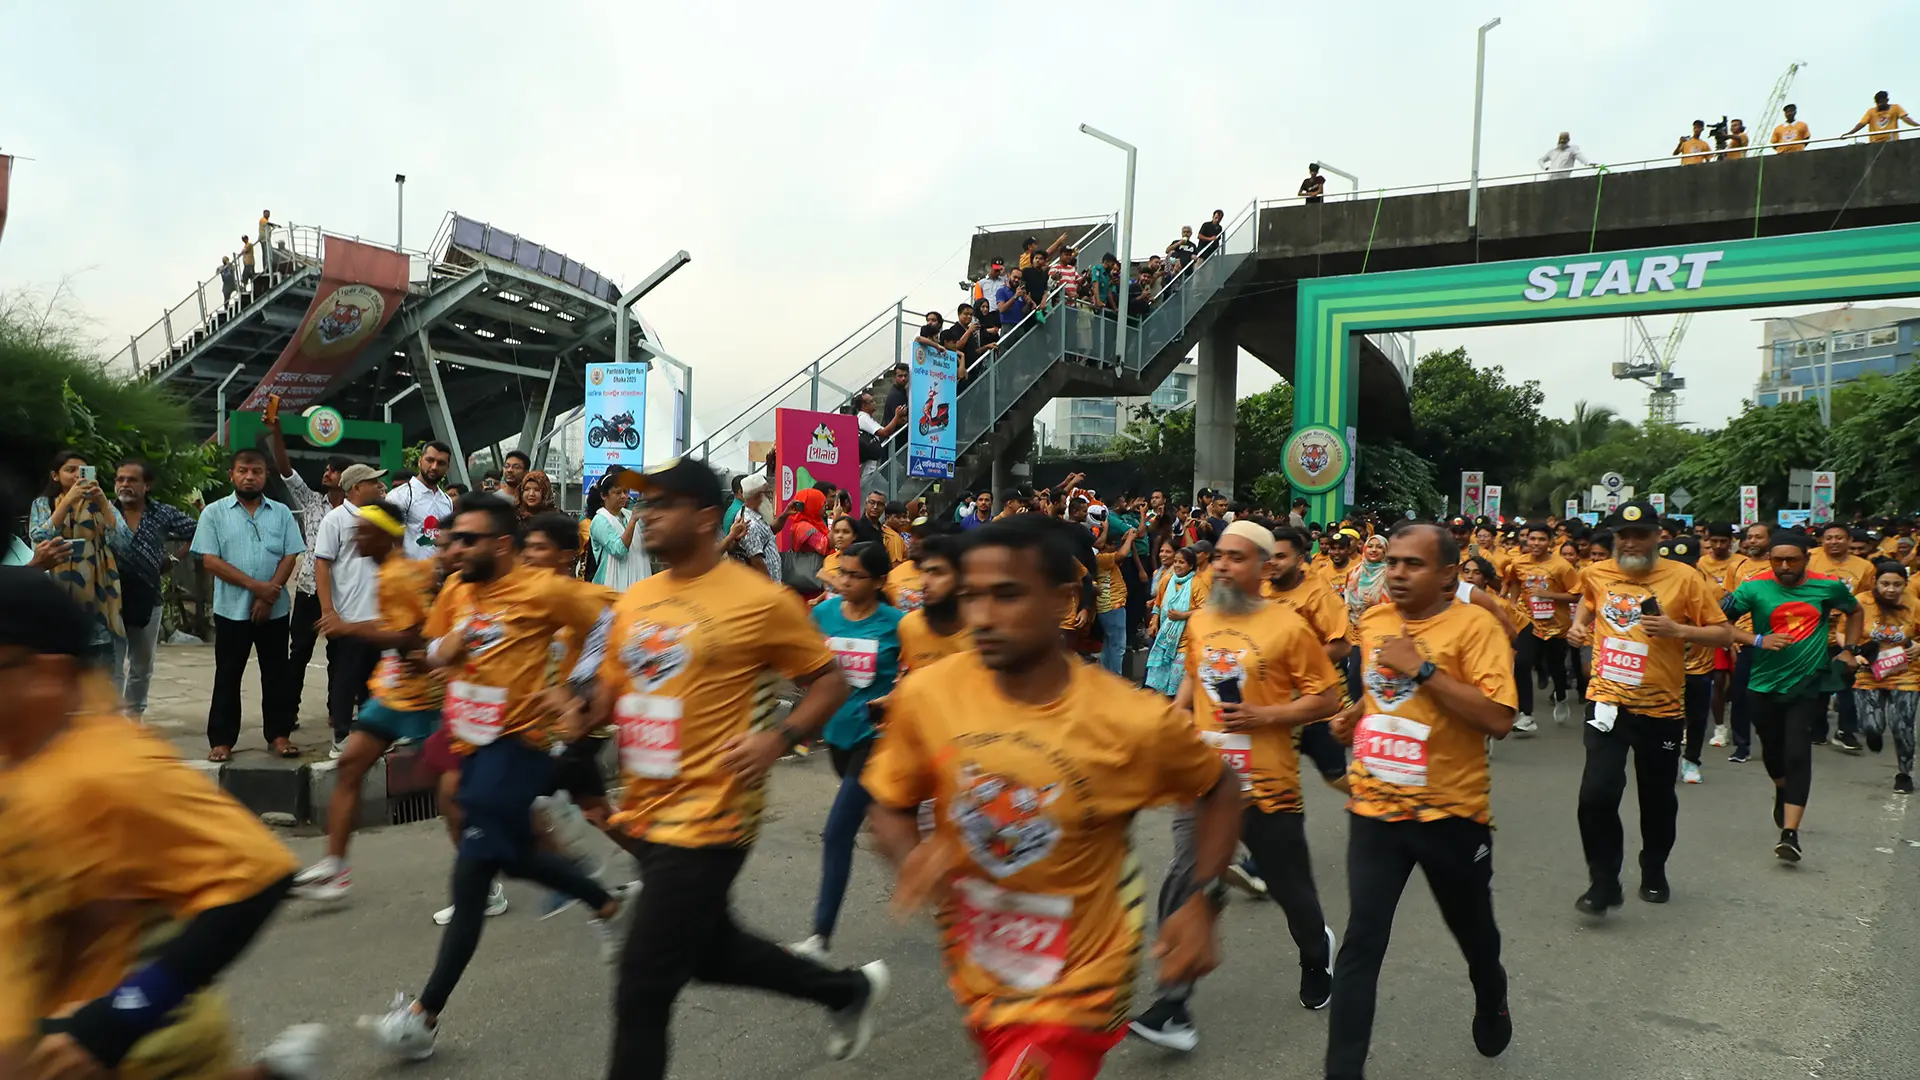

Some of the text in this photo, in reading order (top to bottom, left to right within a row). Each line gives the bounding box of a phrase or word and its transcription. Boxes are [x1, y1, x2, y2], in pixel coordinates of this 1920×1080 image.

[1179, 244, 1194, 252] FILA
[1523, 251, 1724, 301] START
[1299, 432, 1312, 441] Tiger
[1324, 433, 1338, 448] Dhaka
[809, 446, 836, 464] পোলার
[1606, 652, 1642, 669] 1403
[1878, 655, 1904, 668] 1030
[1368, 736, 1422, 760] 1108
